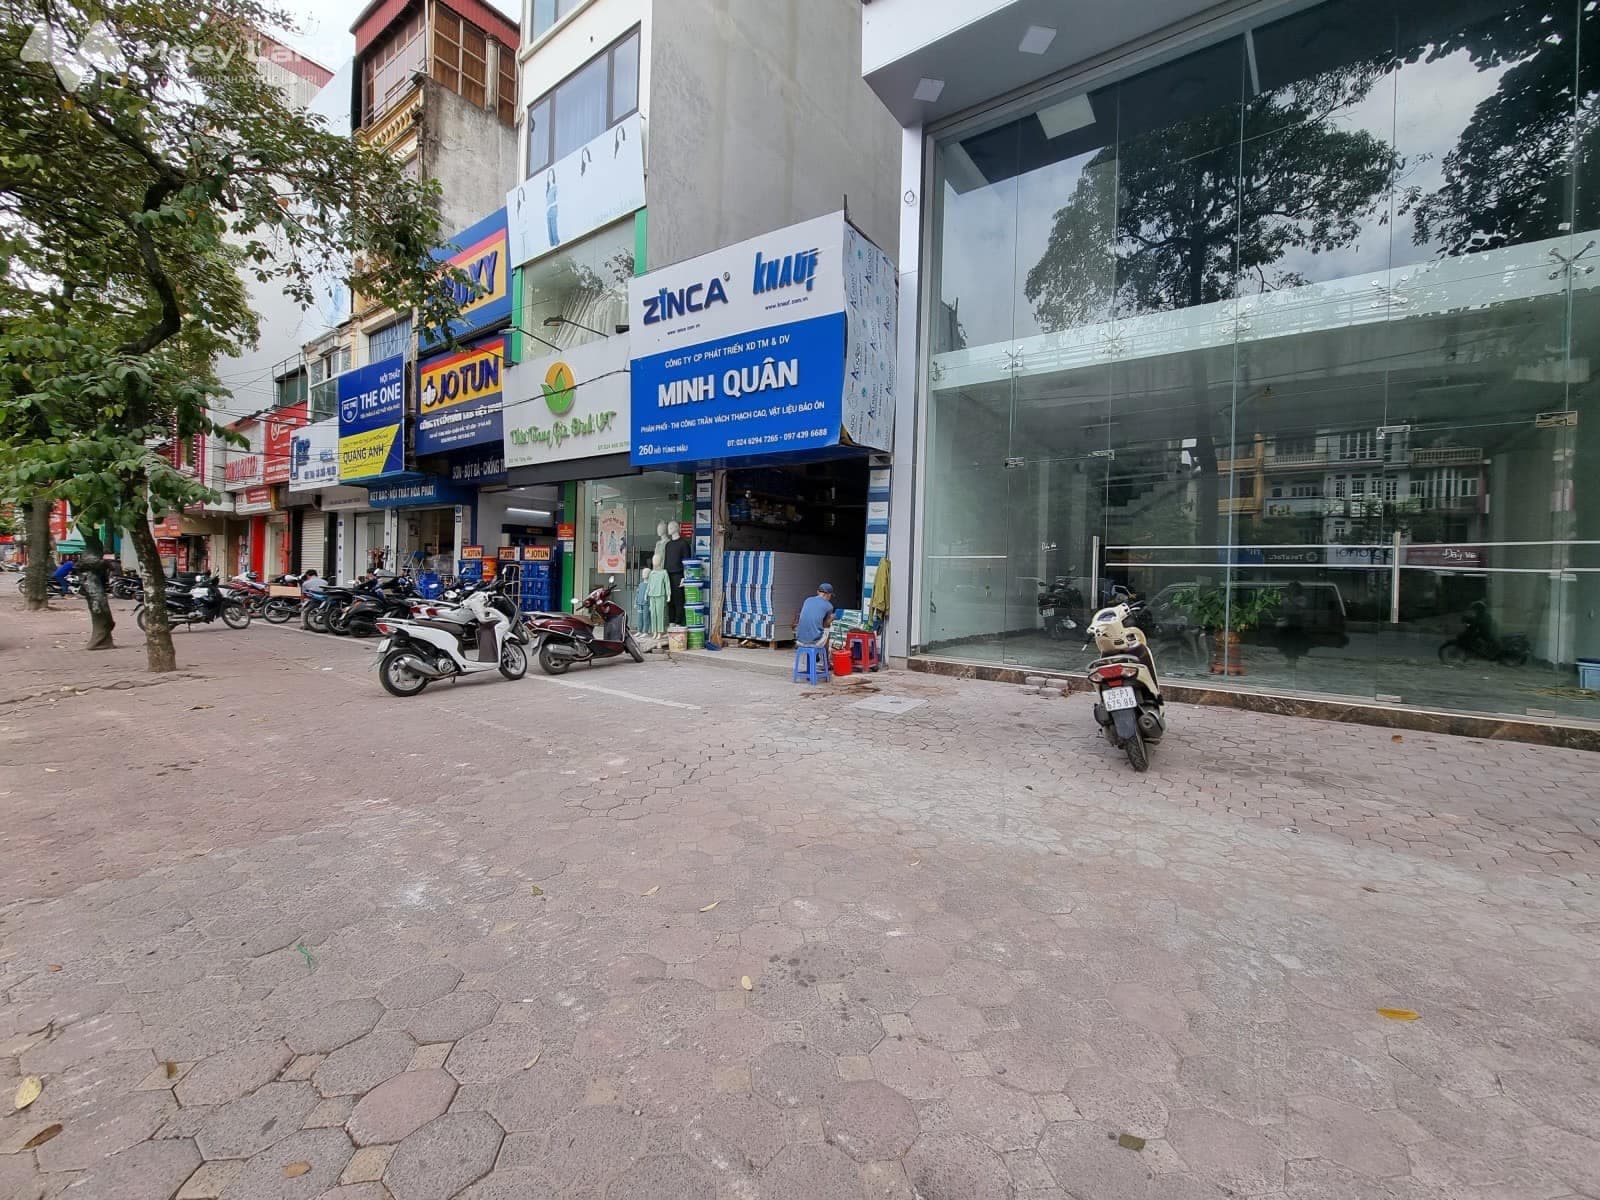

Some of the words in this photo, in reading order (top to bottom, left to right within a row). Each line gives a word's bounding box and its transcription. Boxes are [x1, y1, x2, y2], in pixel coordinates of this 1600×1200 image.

[643, 277, 729, 326] ZINCA
[664, 357, 682, 369] CÔNG
[683, 355, 692, 364] TY
[693, 353, 703, 362] CP
[704, 347, 721, 360] PHÁT
[745, 341, 756, 351] XD
[757, 338, 769, 349] TM
[771, 336, 777, 346] &
[779, 334, 790, 345] DV
[438, 355, 499, 405] JOTUN
[658, 374, 715, 408] MINH
[722, 356, 798, 398] QUÂN
[360, 389, 378, 410] THE
[379, 382, 401, 405] ONE
[783, 432, 796, 441] 097
[810, 428, 828, 438] 6688
[343, 446, 367, 465] QUANG
[368, 442, 384, 459] ANH
[638, 444, 654, 456] 260
[530, 548, 549, 558] JOTUN
